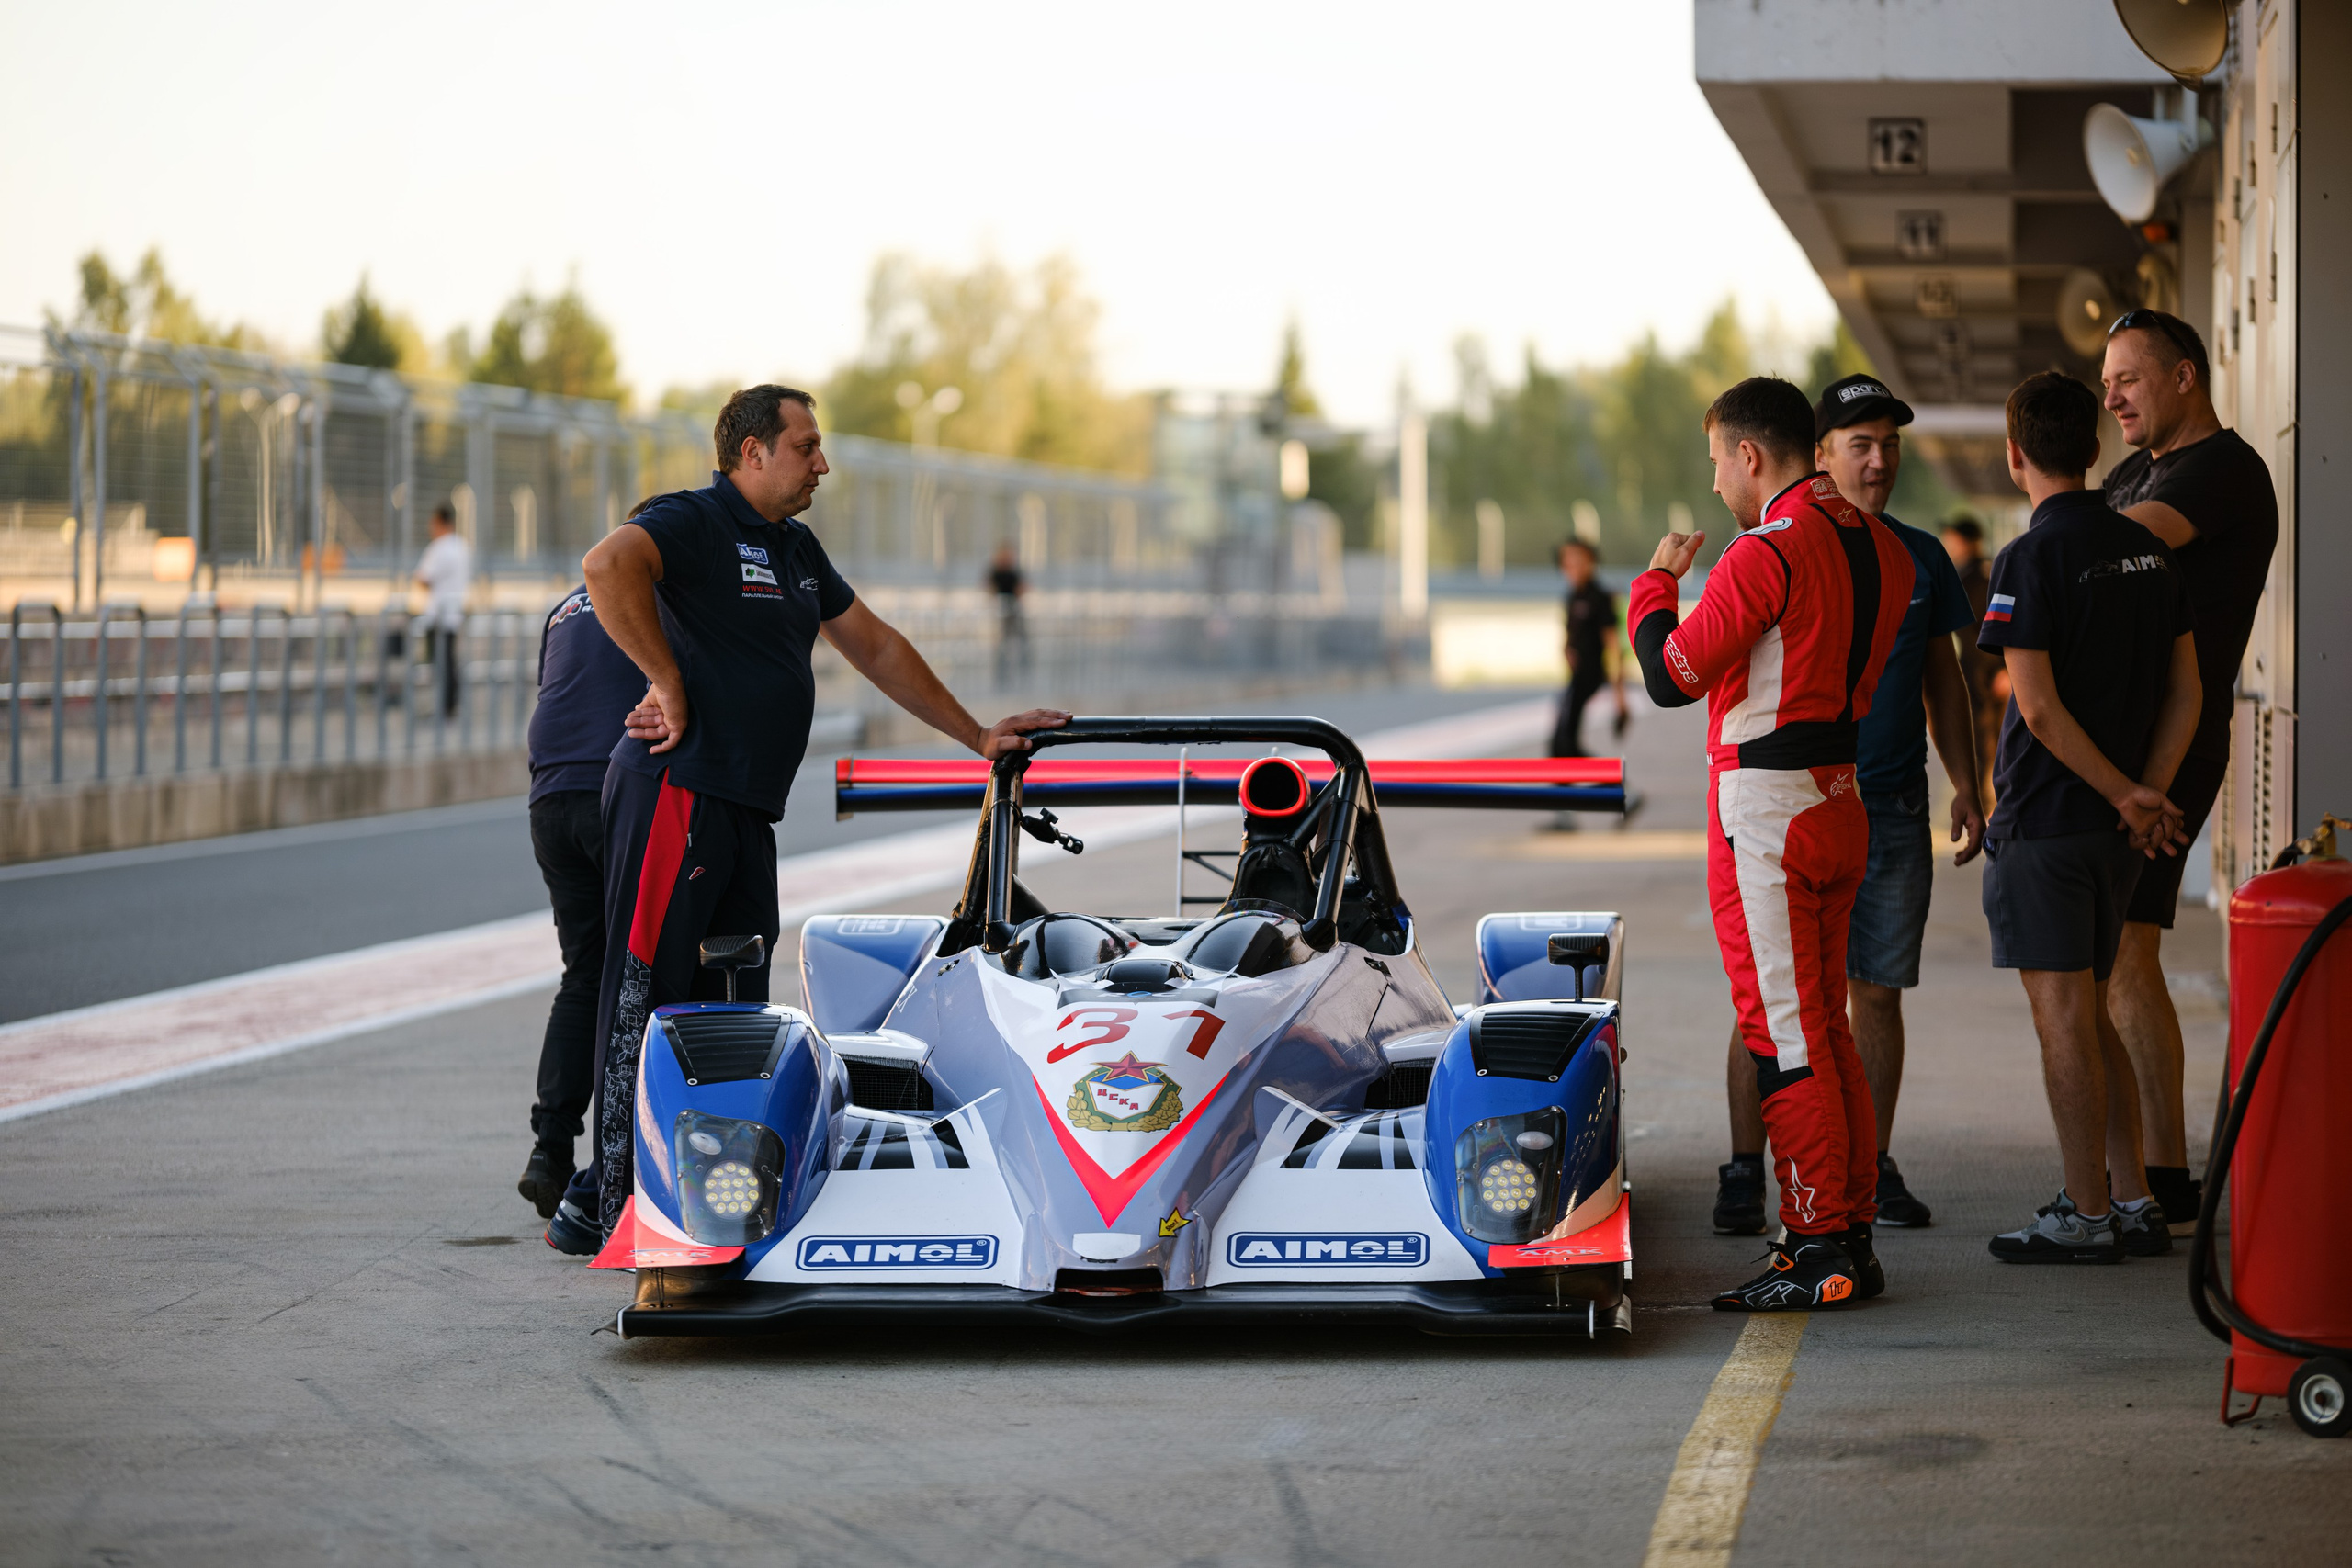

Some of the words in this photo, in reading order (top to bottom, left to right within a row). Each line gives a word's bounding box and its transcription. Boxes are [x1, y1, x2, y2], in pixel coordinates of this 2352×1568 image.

[1874, 128, 1917, 164] 12
[1046, 1007, 1226, 1065] 31
[1097, 1089, 1139, 1111] ЦСКА
[808, 1243, 984, 1263] AIMOL
[1238, 1240, 1417, 1259] AIMOL
